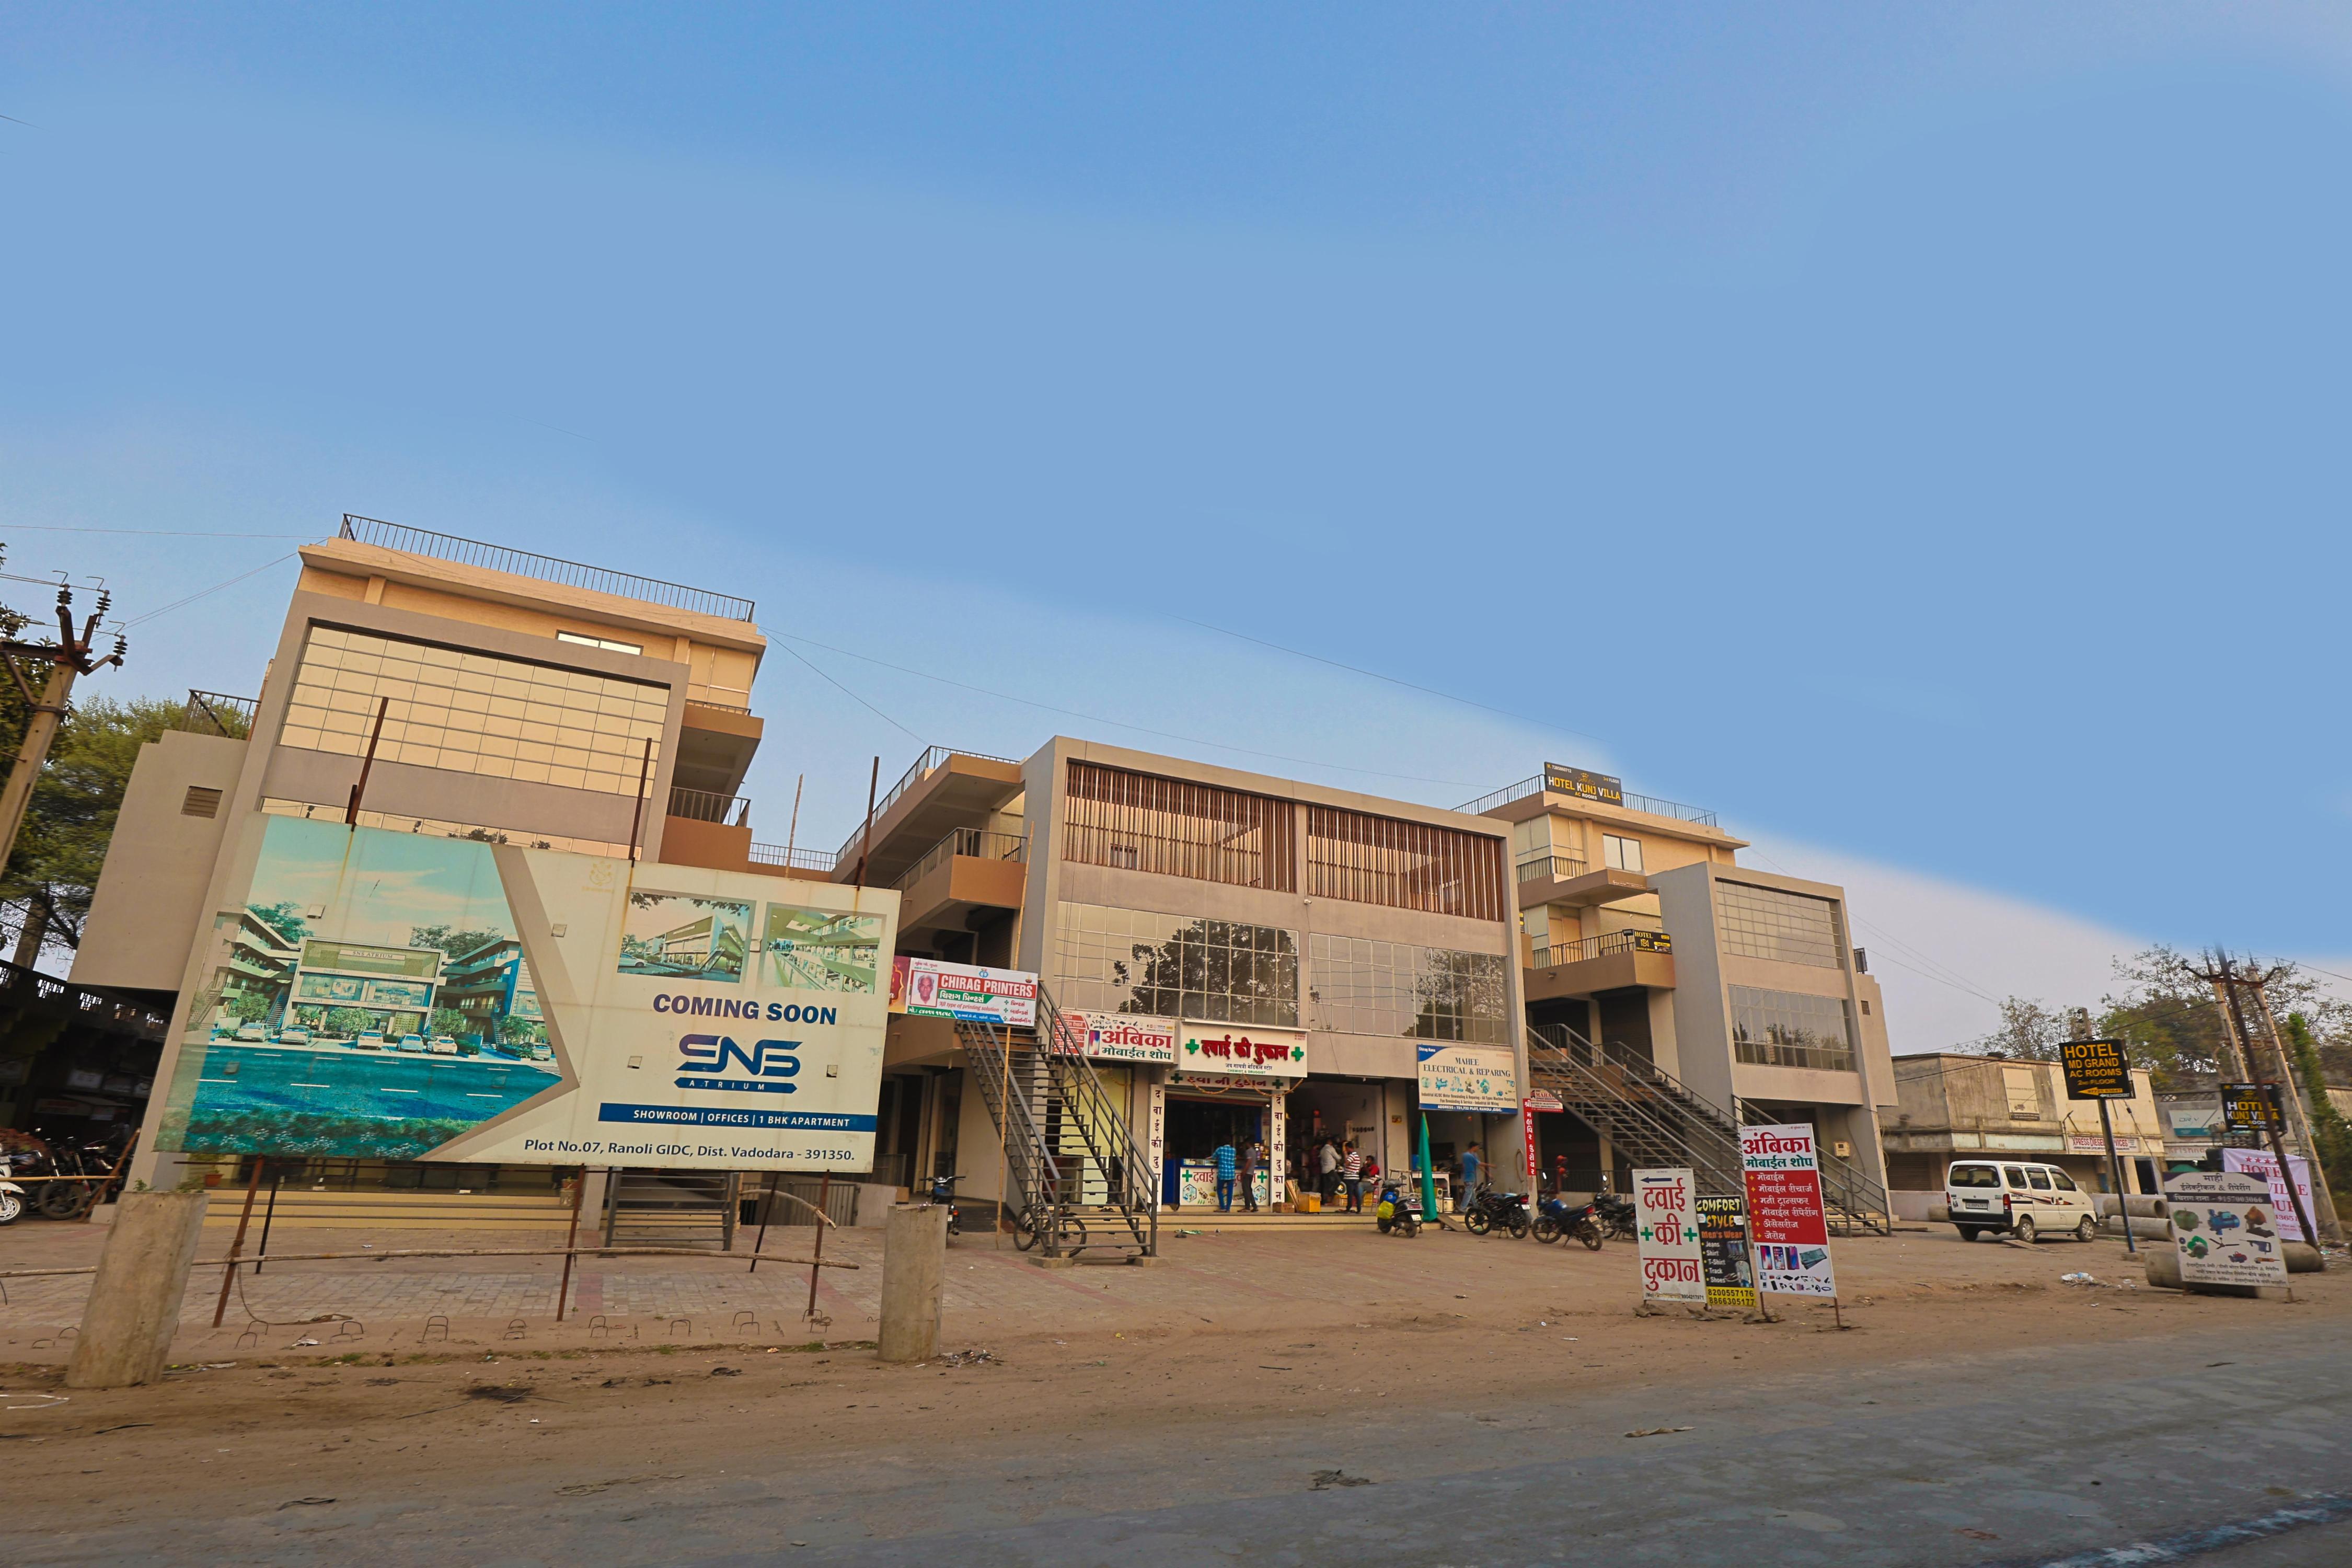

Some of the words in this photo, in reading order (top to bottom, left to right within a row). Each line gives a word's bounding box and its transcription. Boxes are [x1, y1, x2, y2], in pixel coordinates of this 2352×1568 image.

[1548, 776, 1575, 790] HOTEL
[1576, 782, 1596, 794] KUNJ
[1598, 787, 1621, 800] VILLA
[941, 975, 981, 991] CHIRAG
[984, 980, 1033, 997] PRINTERS
[939, 989, 961, 1000] ચિરાગ
[653, 993, 759, 1019] COMING
[766, 1002, 837, 1025] SOON
[1101, 1025, 1173, 1048] अंबिका
[676, 1034, 803, 1077] SNS
[1102, 1045, 1146, 1058] मोबाईल
[1149, 1048, 1172, 1059] शोप
[1201, 1034, 1231, 1059] दवाई
[1233, 1037, 1252, 1058] की
[1253, 1043, 1289, 1065] दुकान
[2065, 1043, 2119, 1058] HOTEL
[1456, 1057, 1479, 1066] MAHEE
[2068, 1059, 2083, 1069] MD
[2084, 1057, 2119, 1068] GRAND
[1423, 1064, 1468, 1074] ELECTRICAL
[1477, 1068, 1511, 1077] REPARING
[2085, 1068, 2123, 1077] ROOMS
[689, 1079, 766, 1091] ATRIUM
[633, 1110, 697, 1121] SHOWROOM
[707, 1113, 749, 1123] OFFICES
[768, 1116, 788, 1124] BHK
[791, 1116, 850, 1127] APARTMENT
[2251, 1111, 2280, 1121] VILA
[1743, 1132, 1811, 1154] अंबिका
[2071, 1136, 2090, 1146] XPRESS
[524, 1139, 555, 1151] Plot
[558, 1140, 604, 1154] No.07,
[608, 1143, 652, 1155] Ranoli
[656, 1144, 694, 1157] GIDC,
[697, 1146, 727, 1157] Dist.
[731, 1147, 793, 1159] Vadodara
[804, 1149, 855, 1160] 391350.
[1745, 1155, 1786, 1169] मोबाईल
[1790, 1154, 1813, 1167] शोप
[1193, 1168, 1215, 1183] दवाई
[1757, 1172, 1785, 1182] मोबाईल
[2203, 1173, 2223, 1182] माही
[1642, 1177, 1686, 1212] दवाई
[1758, 1183, 1786, 1194] मोबाईल
[1788, 1183, 1813, 1193] रीचार्ज
[1760, 1195, 1775, 1205] मनी
[2174, 1193, 2195, 1202] चिराग
[1696, 1198, 1740, 1212] COMFORT
[1761, 1207, 1790, 1218] मोबाईल
[1654, 1213, 1682, 1245] की
[1707, 1215, 1735, 1229] STYLE
[1701, 1230, 1723, 1239] Men's
[1643, 1258, 1700, 1292] दुकान
[1709, 1297, 1755, 1306] 8866305177
